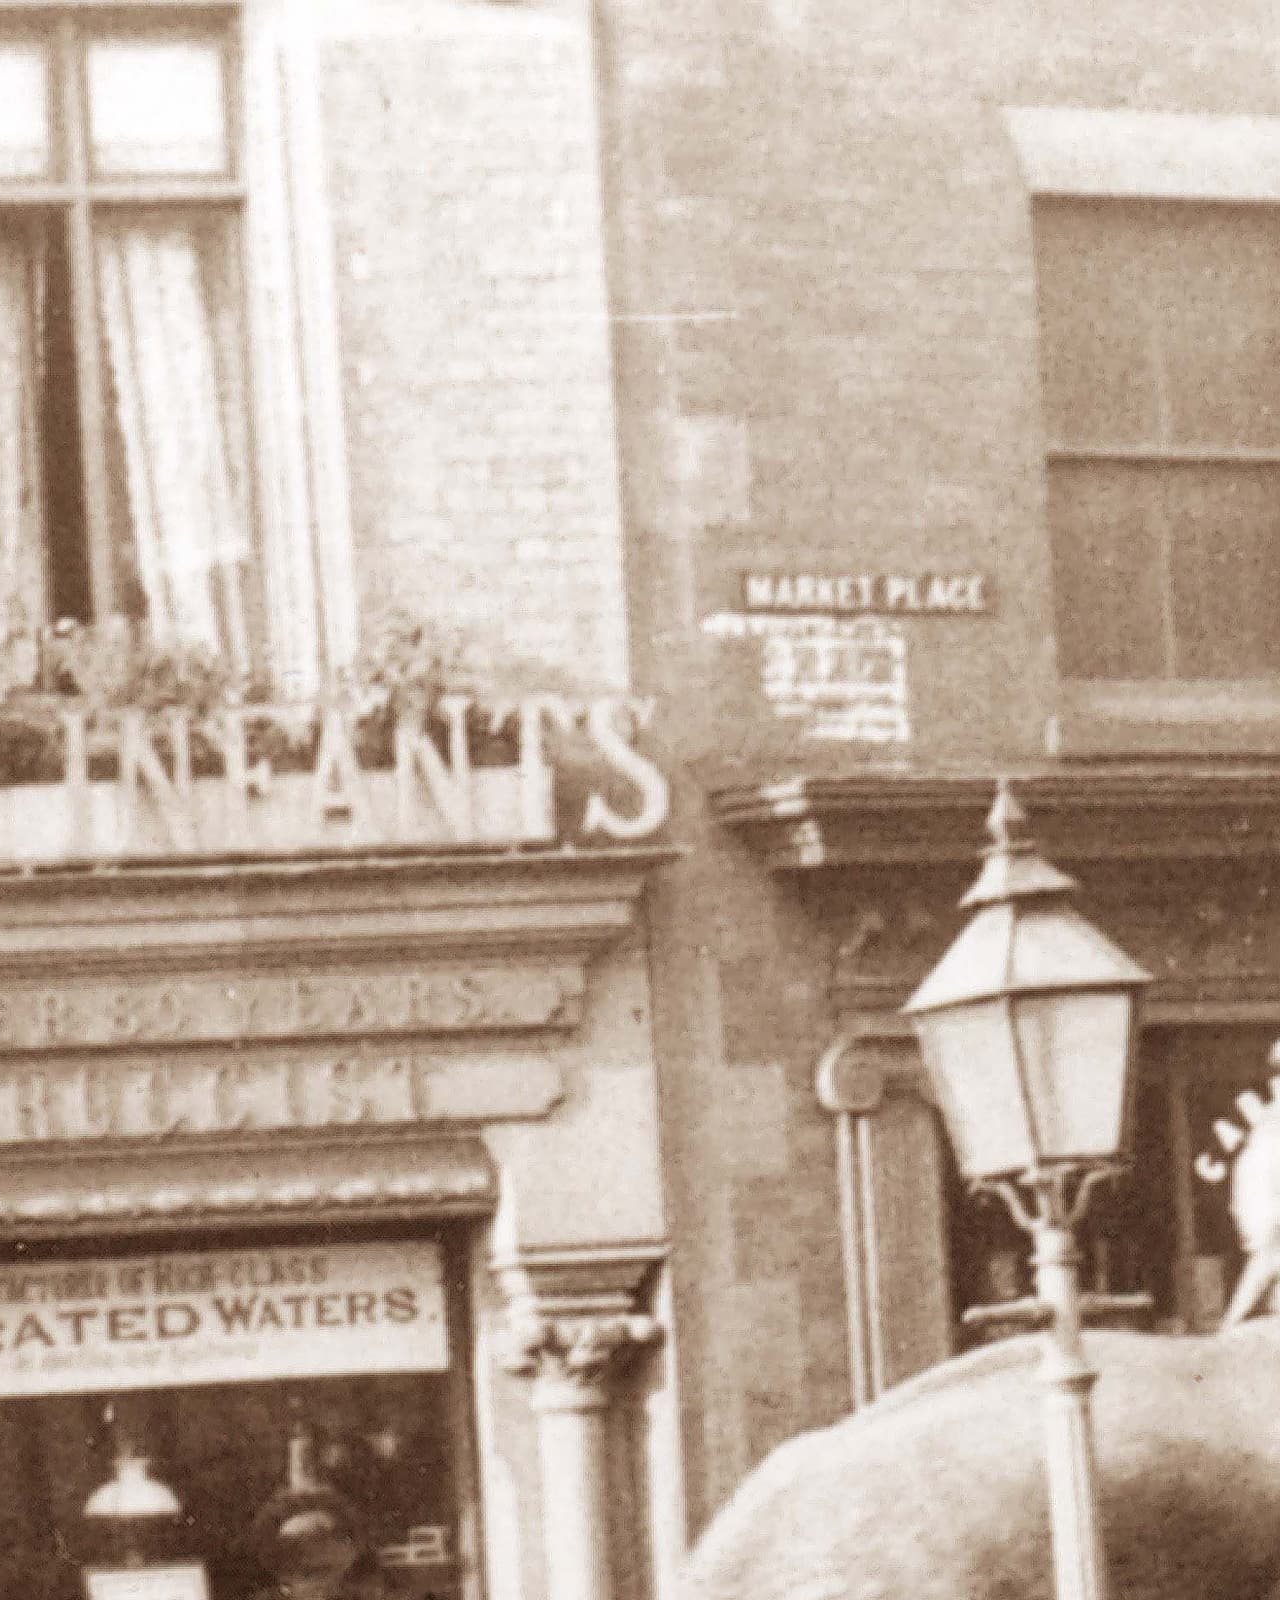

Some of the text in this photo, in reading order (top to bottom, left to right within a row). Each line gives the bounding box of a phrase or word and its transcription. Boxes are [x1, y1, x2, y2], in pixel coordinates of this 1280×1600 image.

[745, 574, 986, 611] MARKET PLACE
[56, 692, 672, 860] INFANTS
